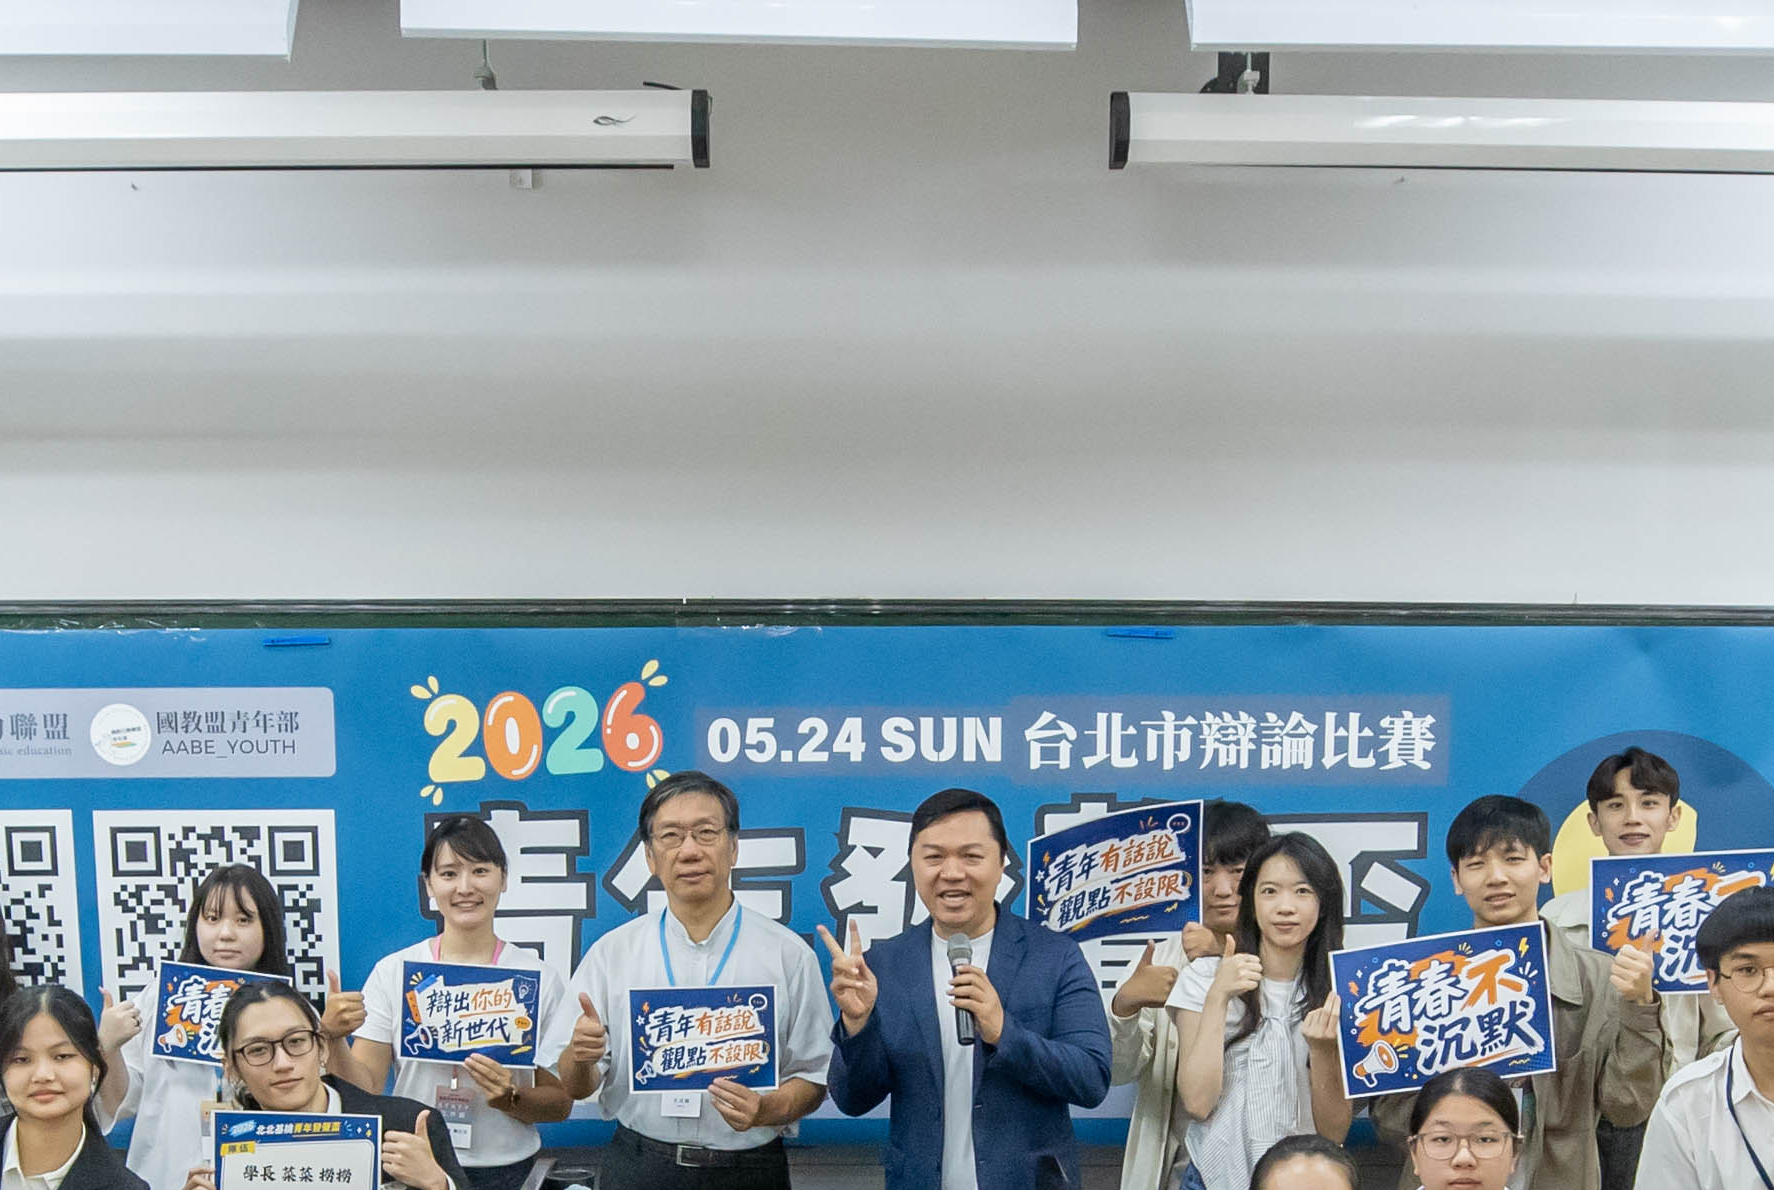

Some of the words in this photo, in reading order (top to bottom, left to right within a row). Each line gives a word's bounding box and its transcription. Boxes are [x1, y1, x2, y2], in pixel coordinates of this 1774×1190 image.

[156, 710, 300, 735] 國教盟青年部
[424, 682, 663, 783] 2026
[15, 746, 73, 758] education
[162, 739, 296, 758] AABE_YOUTH
[706, 716, 866, 765] 05.24
[880, 715, 1003, 764] SUN
[1023, 709, 1439, 773] 台北市辯論比賽
[1049, 833, 1175, 896] 青年有話說
[1057, 873, 1184, 928] 觀點不設限
[426, 988, 513, 1018] 辯出你的
[1368, 955, 1523, 1035] 青春不
[439, 1016, 512, 1044] 新世代
[649, 1008, 755, 1042] 青年有話說
[1422, 1000, 1531, 1068] 沉默
[660, 1043, 765, 1073] 觀點不設限
[243, 1165, 277, 1183] 學長
